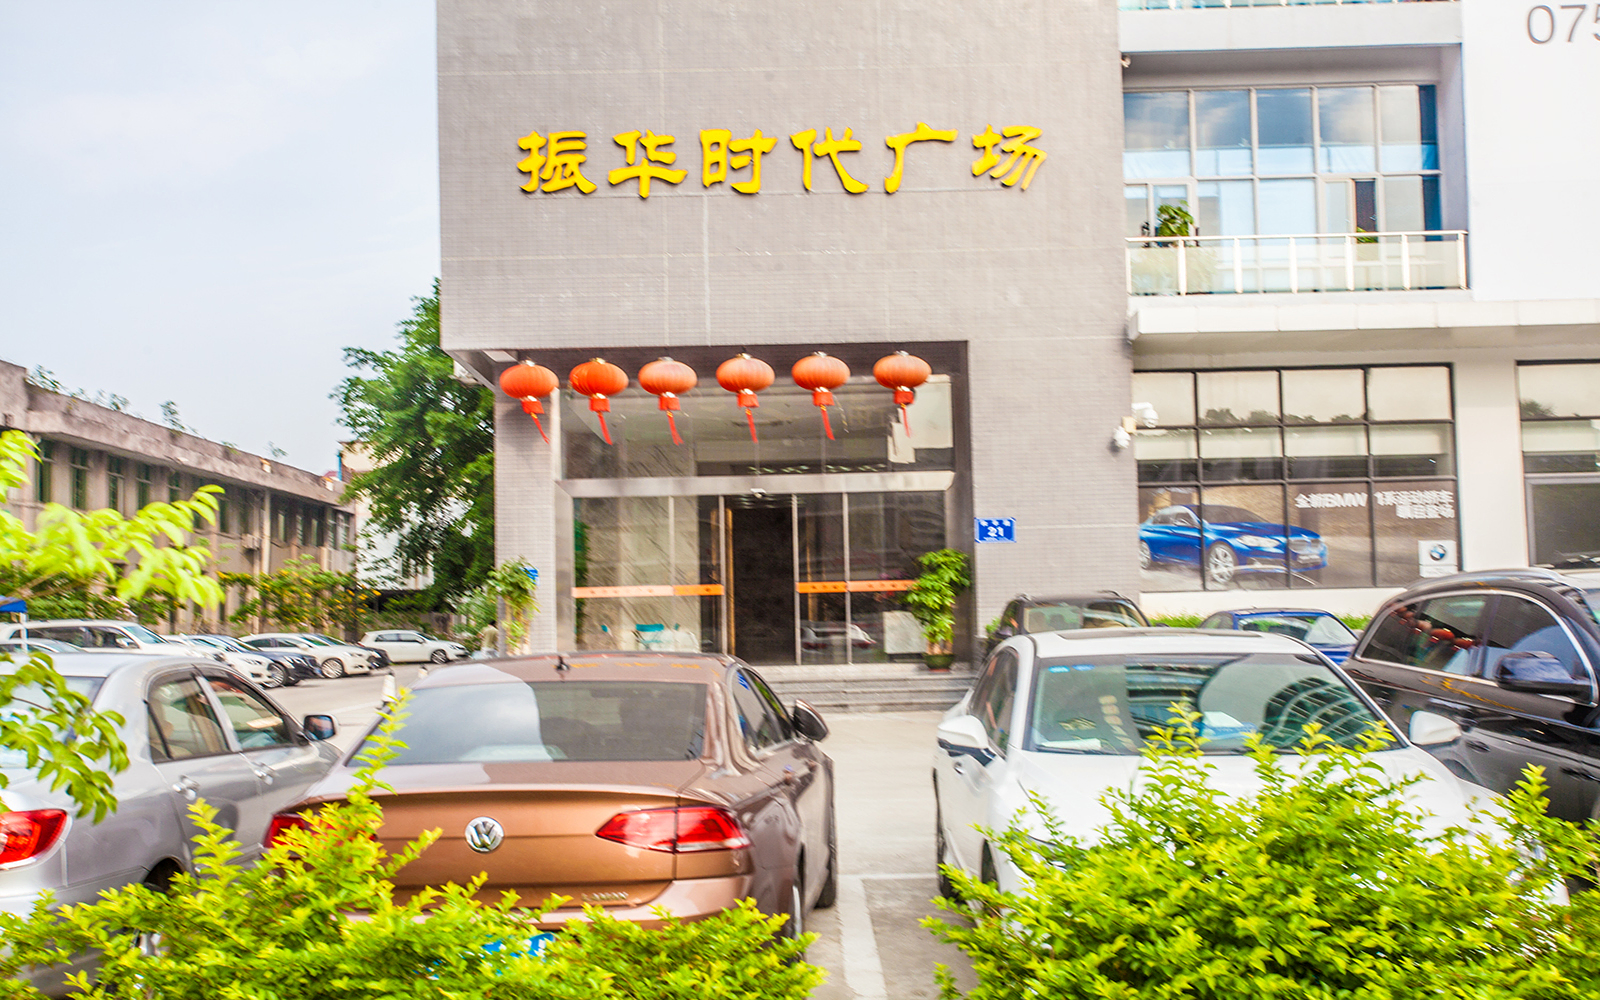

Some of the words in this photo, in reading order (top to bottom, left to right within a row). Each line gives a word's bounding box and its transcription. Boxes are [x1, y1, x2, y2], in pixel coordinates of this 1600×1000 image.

[516, 121, 1048, 198] 振华时代广场
